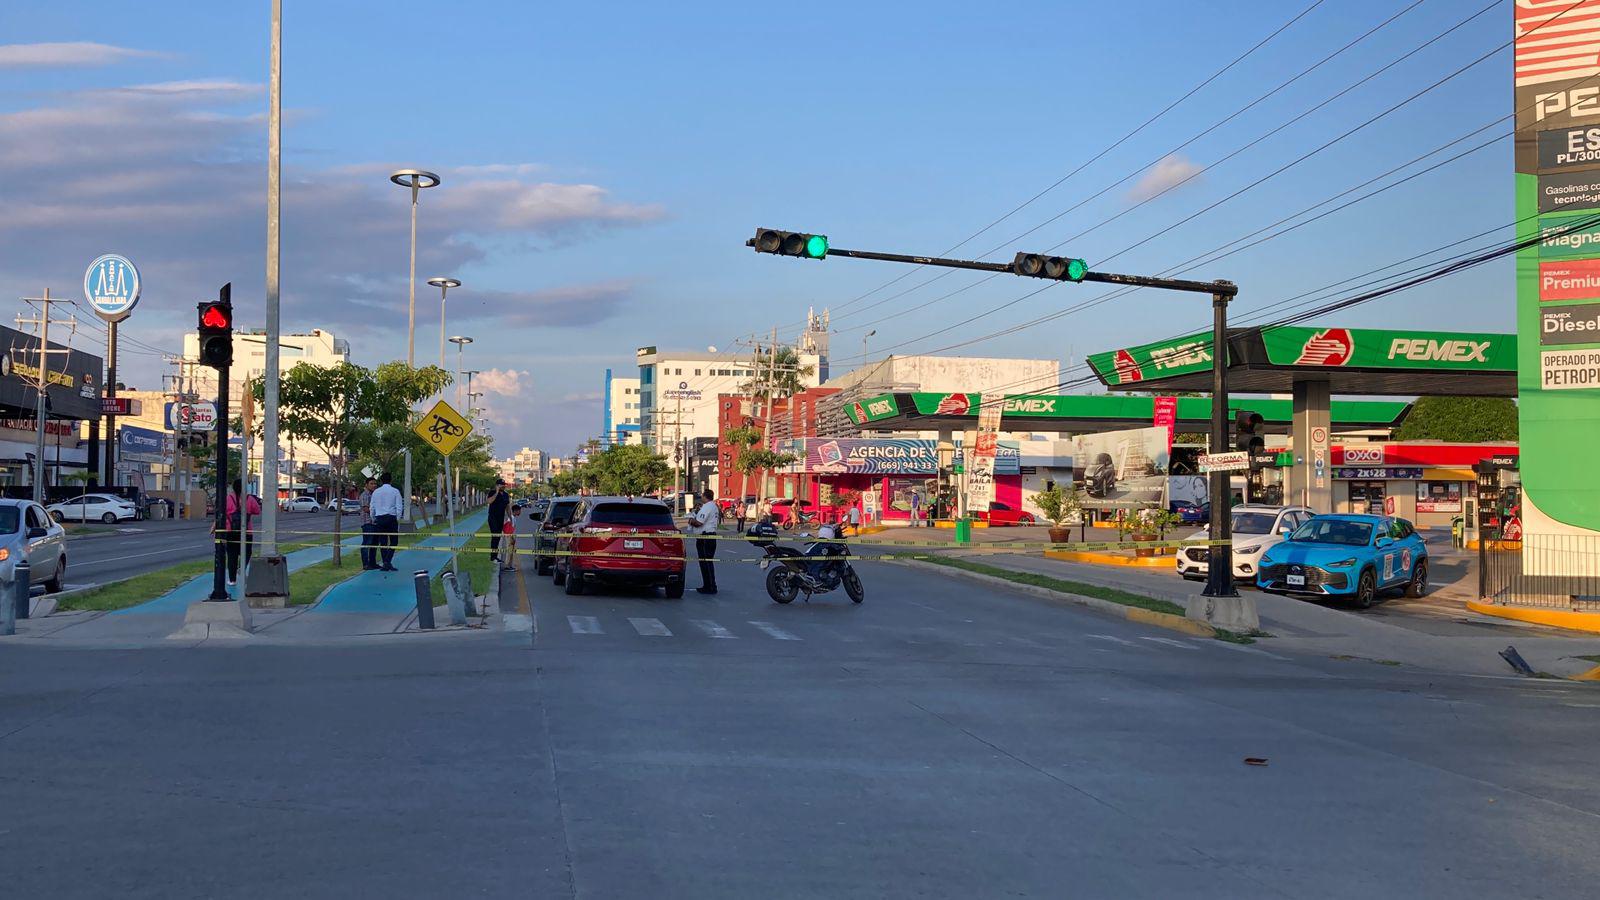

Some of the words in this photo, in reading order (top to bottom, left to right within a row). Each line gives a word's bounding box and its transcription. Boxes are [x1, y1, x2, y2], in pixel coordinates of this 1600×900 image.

[1545, 184, 1589, 195] Gasolinas
[1543, 315, 1600, 333] Diesel
[1149, 340, 1212, 370] PEMEX
[1388, 338, 1490, 363] PEMEX
[1544, 354, 1586, 367] OPERADO
[1002, 399, 1055, 413] EMEX
[849, 446, 906, 458] AGENCIA
[909, 447, 926, 458] DE
[1346, 449, 1380, 462] OXXO
[878, 461, 900, 471] (669)
[902, 461, 918, 469] 941
